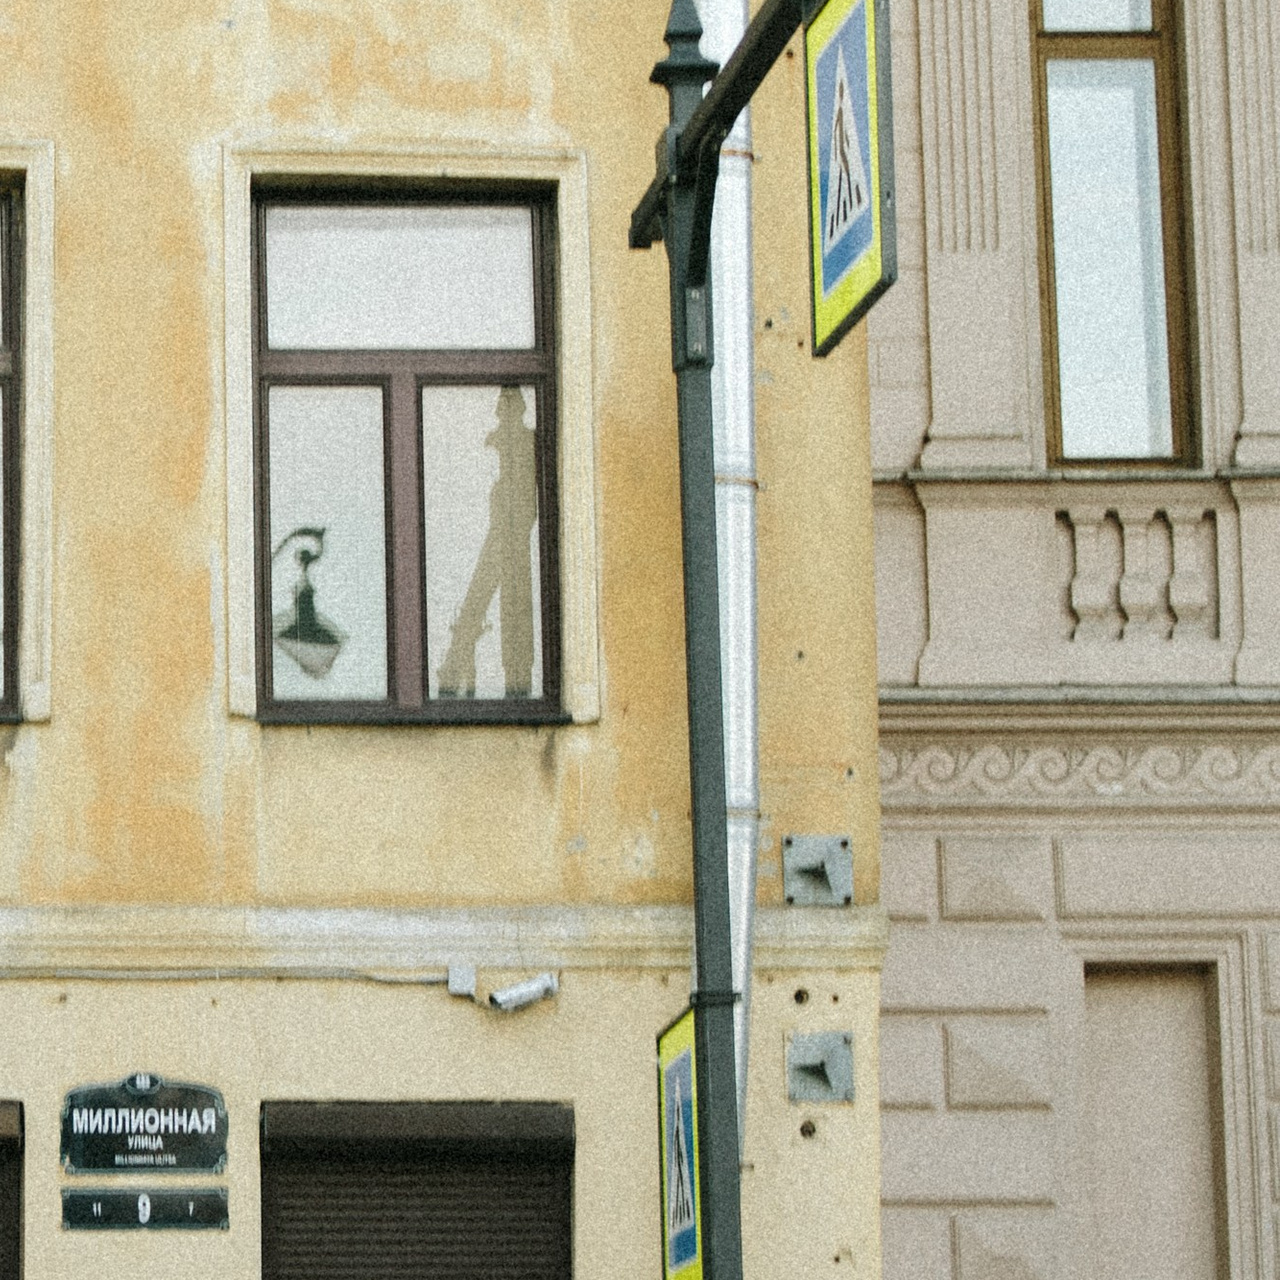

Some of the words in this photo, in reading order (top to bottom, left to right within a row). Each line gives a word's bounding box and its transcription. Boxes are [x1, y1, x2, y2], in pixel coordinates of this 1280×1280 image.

[73, 1108, 216, 1134] МИЛЛИОННАЯ
[128, 1135, 163, 1150] УЛИЦА
[93, 1202, 101, 1216] 11
[138, 1193, 150, 1224] 9
